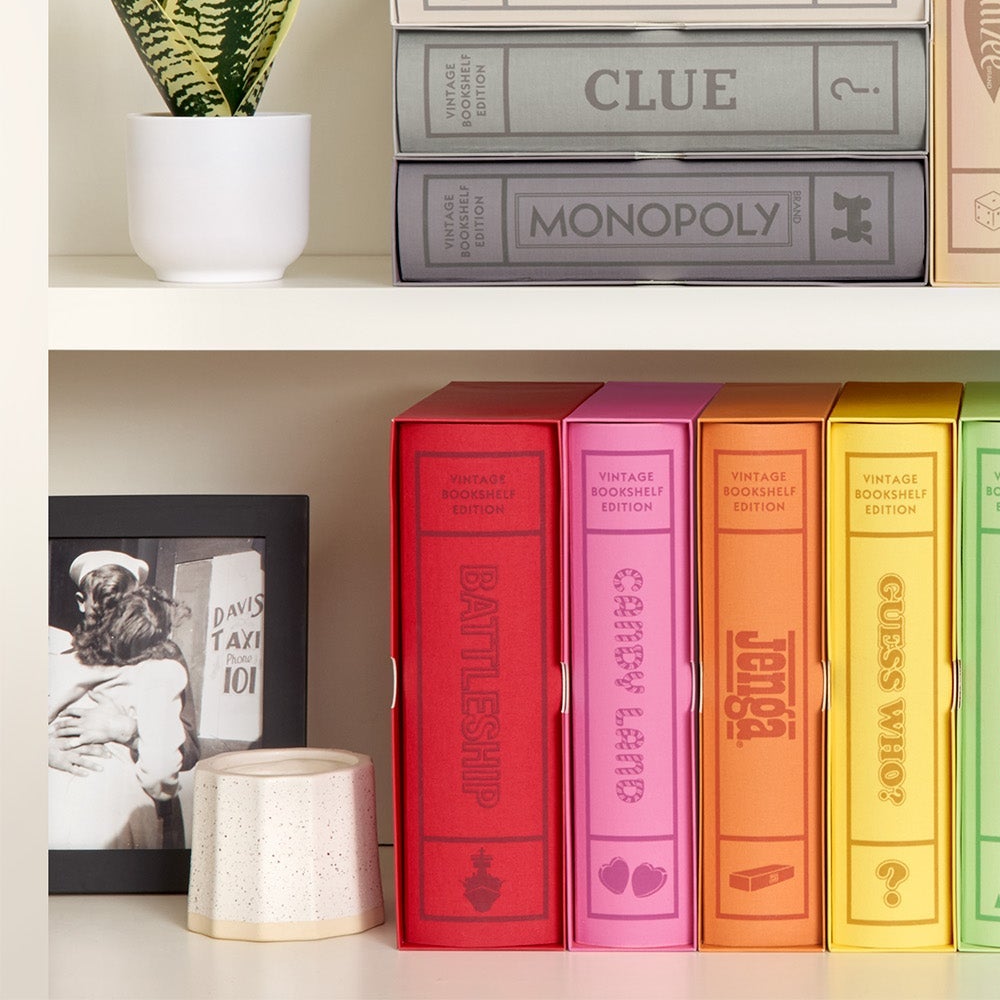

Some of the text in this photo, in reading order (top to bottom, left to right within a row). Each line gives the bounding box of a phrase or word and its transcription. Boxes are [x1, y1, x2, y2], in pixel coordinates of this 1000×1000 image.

[445, 63, 456, 120] VINTAGE
[460, 53, 472, 128] BOOKSHELF
[475, 64, 487, 117] EDITION
[584, 69, 738, 112] CLUE
[793, 190, 802, 225] BRAND
[443, 194, 455, 250] VINTAGE
[458, 184, 471, 258] BOOKSHELF
[473, 195, 485, 248] EDITION
[529, 202, 781, 238] MONOPOLY
[449, 473, 506, 485] VINTAGE
[598, 471, 654, 483] VINTAGE
[731, 471, 787, 482] VINTAGE
[862, 473, 918, 485] VINTAGE
[441, 488, 516, 500] BOOKSHELF
[591, 486, 664, 498] BOOKSHELF
[723, 485, 797, 497] BOOKSHELF
[854, 488, 928, 500] BOOKSHELF
[452, 504, 505, 516] EDITION
[601, 501, 653, 513] EDITION
[733, 501, 786, 512] EDITION
[865, 504, 917, 515] EDITION
[213, 593, 264, 628] DAVIS
[211, 629, 261, 651] TAXI
[459, 564, 500, 809] BATTLESHIP
[877, 572, 908, 806] GUESS WHO?
